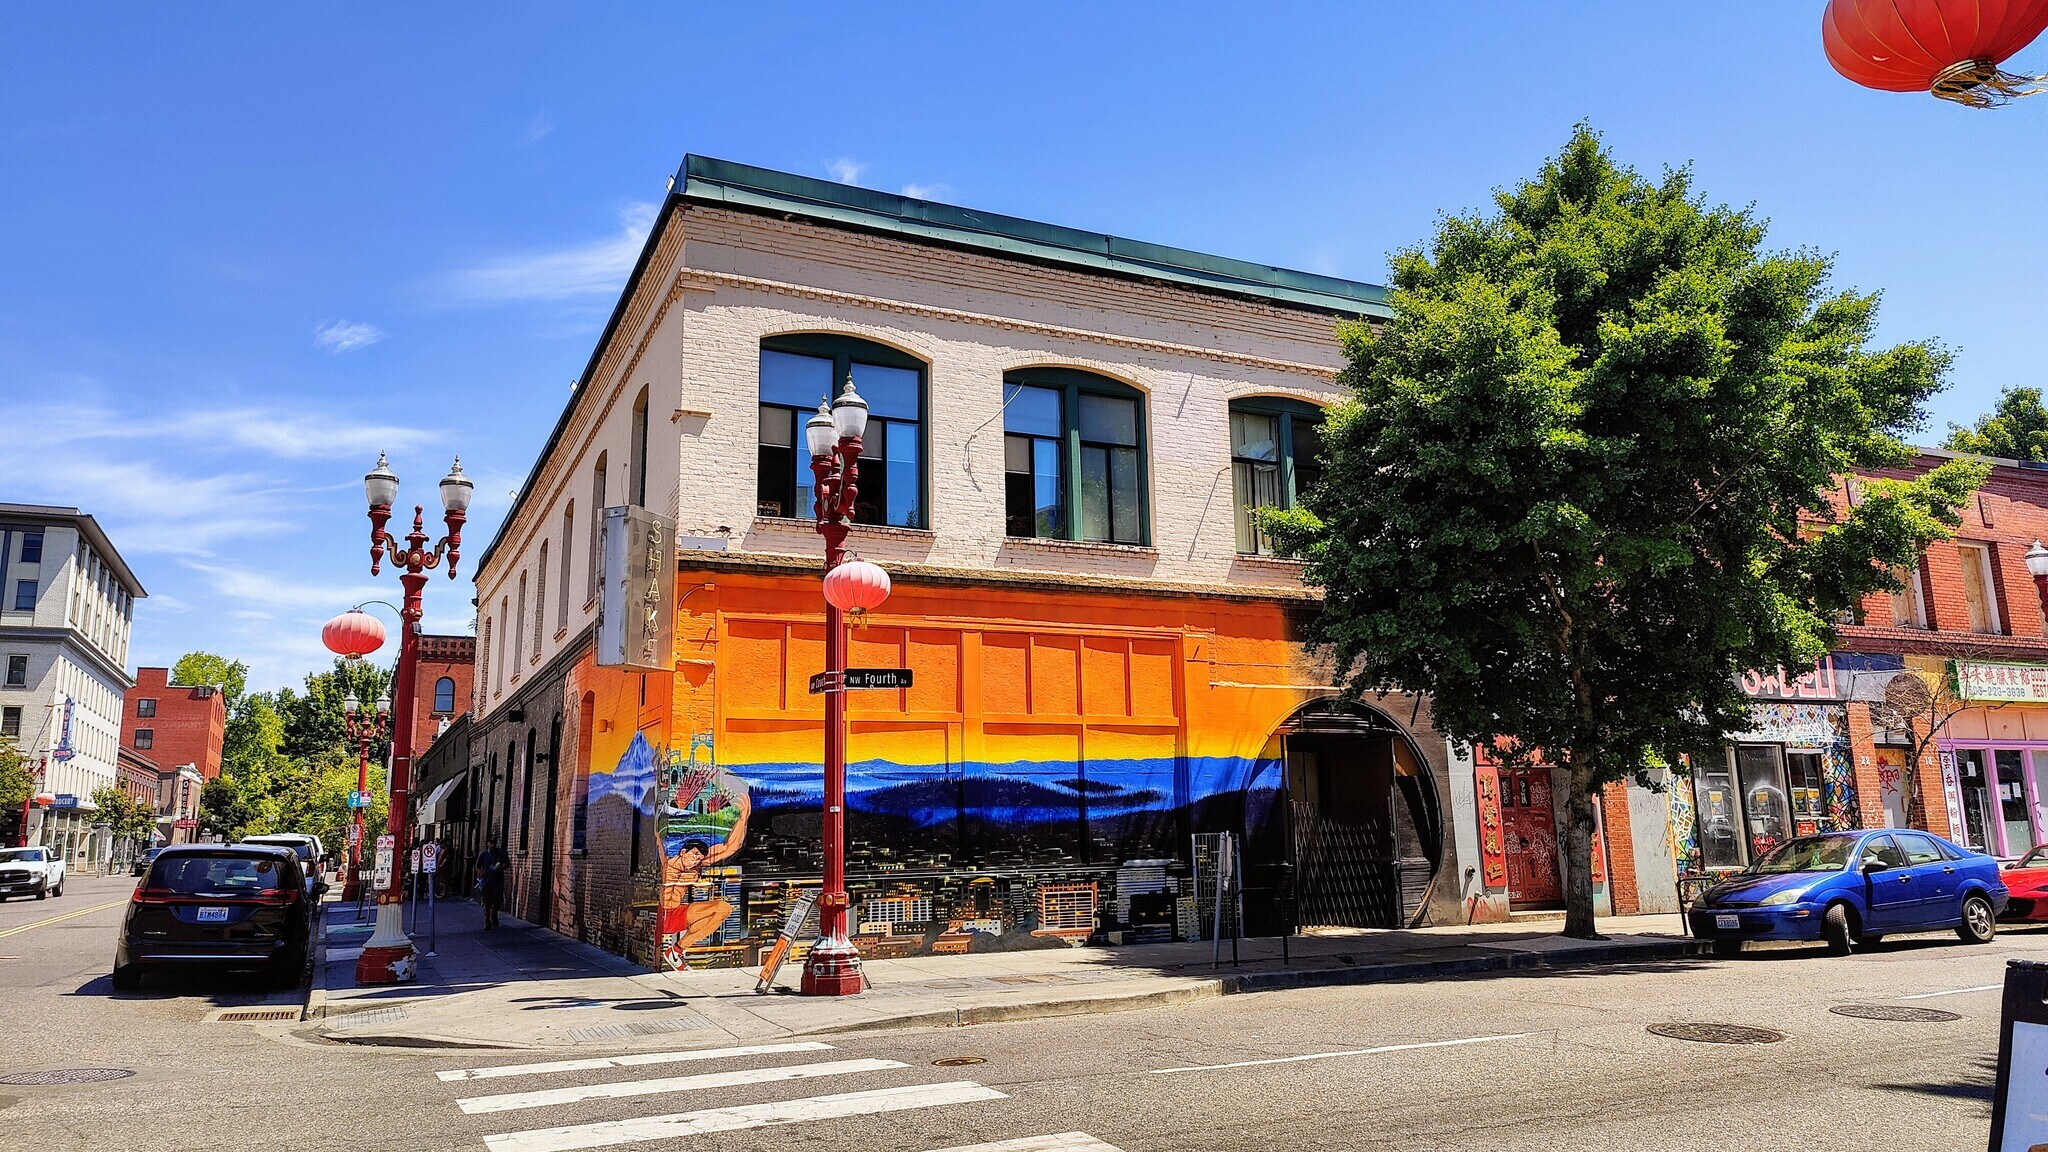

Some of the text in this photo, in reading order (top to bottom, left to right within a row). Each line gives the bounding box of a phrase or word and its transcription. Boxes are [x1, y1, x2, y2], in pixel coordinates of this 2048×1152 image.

[849, 676, 861, 684] NW
[865, 673, 897, 684] Fourth
[61, 703, 71, 748] HOTEL
